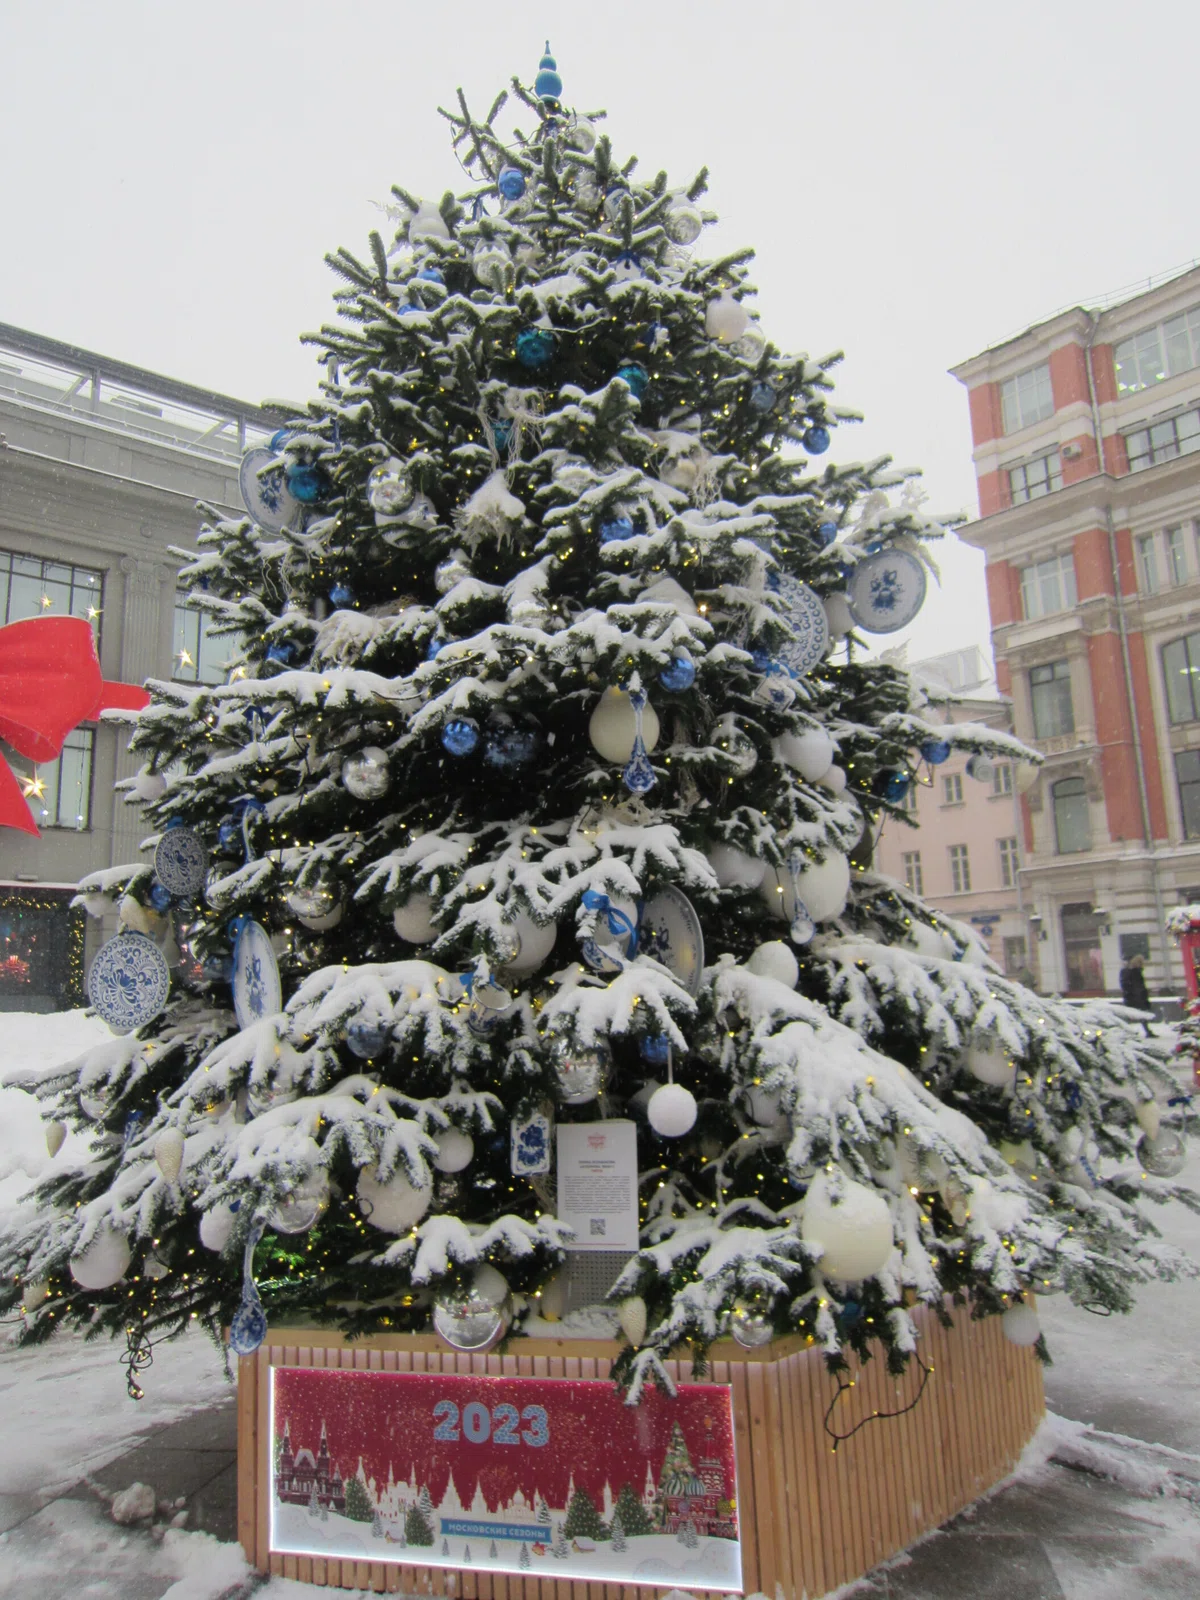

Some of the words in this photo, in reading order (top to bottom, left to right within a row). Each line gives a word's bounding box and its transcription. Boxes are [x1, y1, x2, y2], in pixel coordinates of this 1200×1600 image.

[433, 1400, 550, 1447] 2023
[448, 1523, 507, 1535] МОСКОВСКИЕ
[508, 1528, 546, 1538] СЕЗОНЫ
